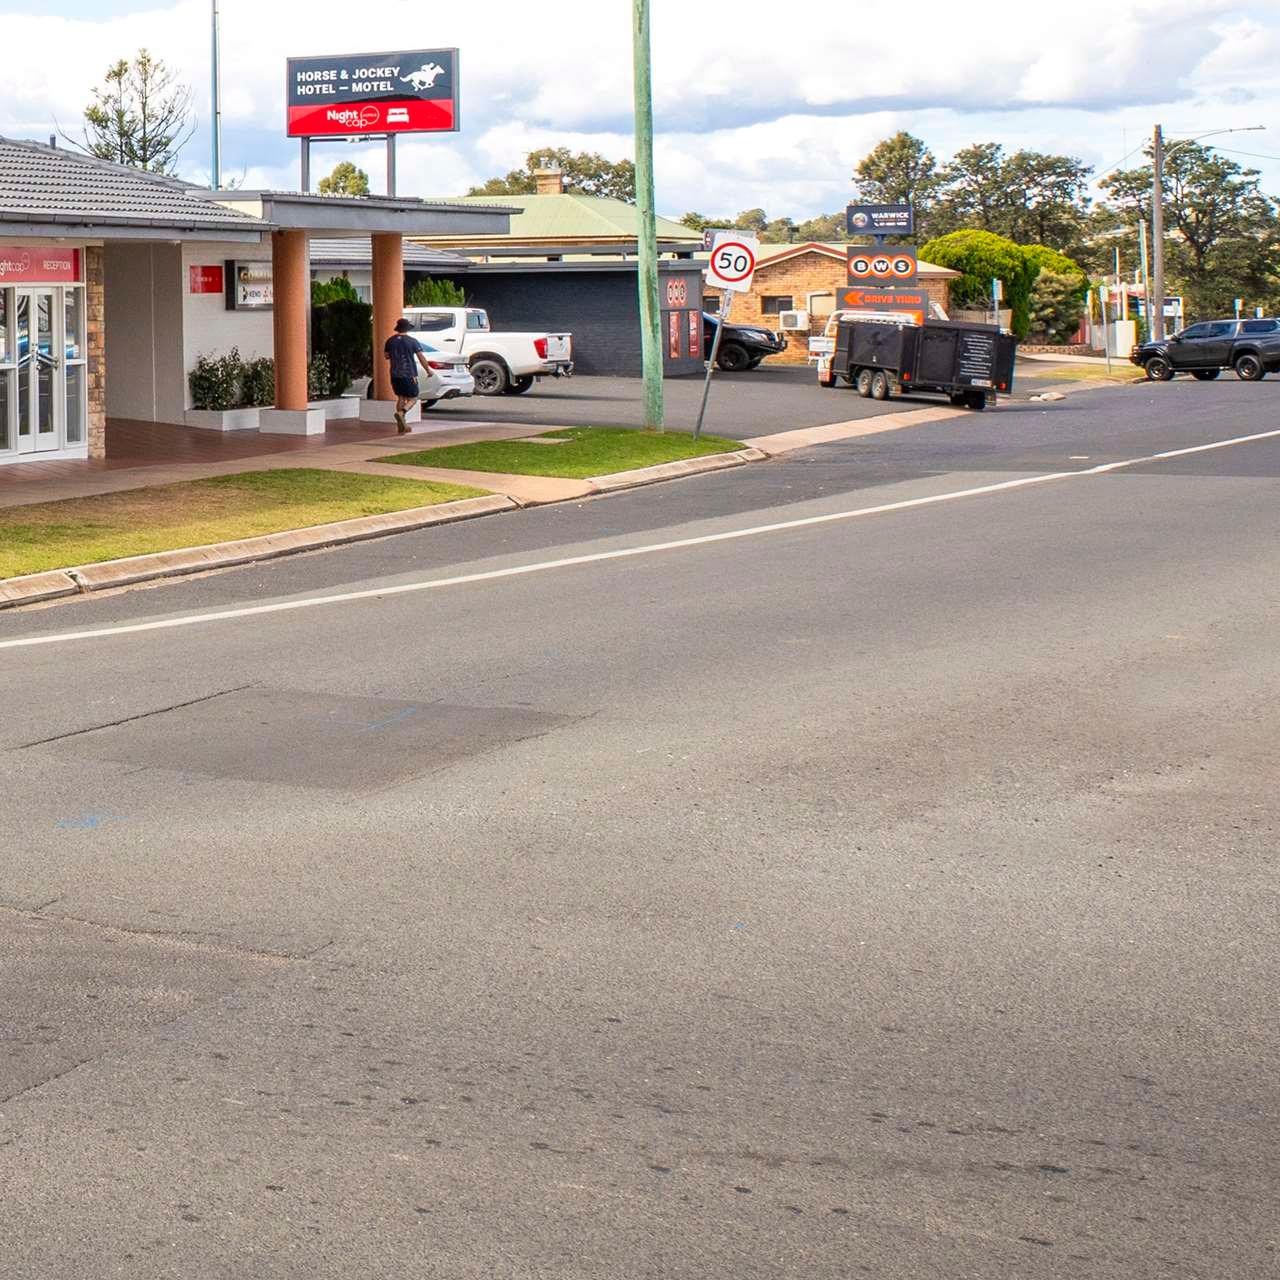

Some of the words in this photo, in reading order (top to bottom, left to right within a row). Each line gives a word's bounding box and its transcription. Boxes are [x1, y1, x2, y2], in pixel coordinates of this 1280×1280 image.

[297, 70, 337, 82] HORSE
[340, 70, 349, 80] &
[352, 67, 401, 79] JOCKEY
[297, 83, 336, 95] HOTEL
[352, 81, 394, 93] MOTEL
[327, 109, 358, 124] Night
[345, 118, 368, 128] cap
[43, 260, 71, 270] RECEPTION
[718, 252, 748, 272] 50
[864, 295, 893, 304] DRIVE
